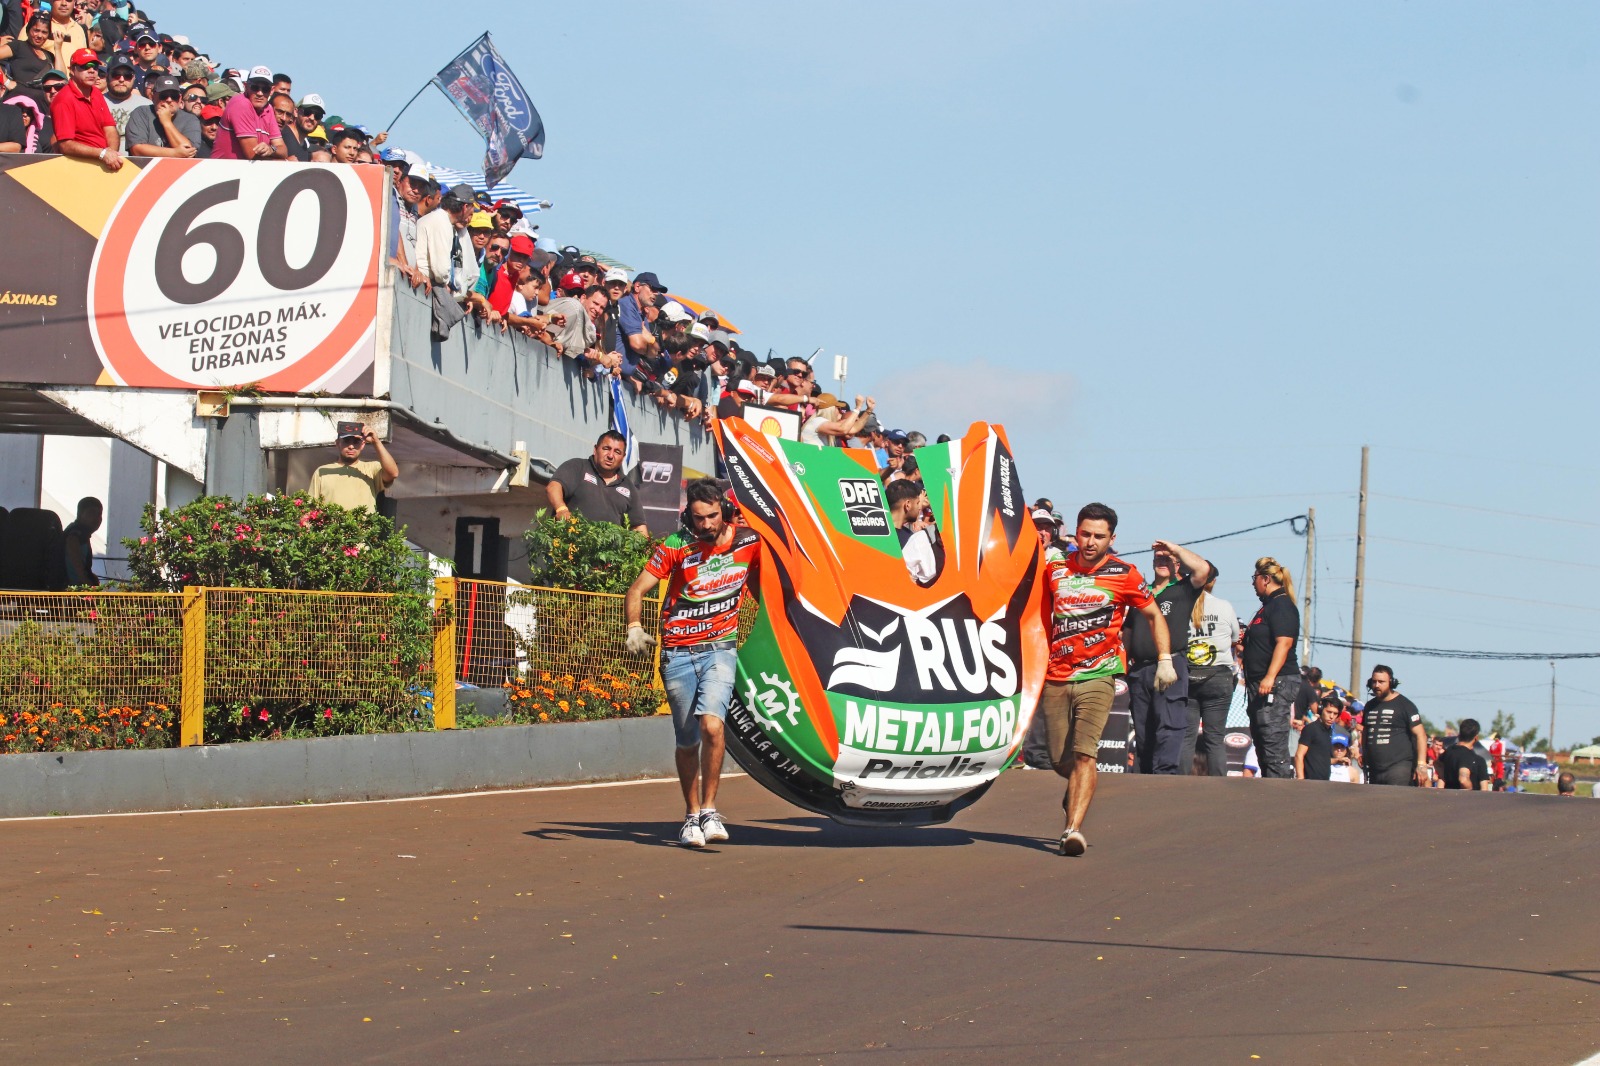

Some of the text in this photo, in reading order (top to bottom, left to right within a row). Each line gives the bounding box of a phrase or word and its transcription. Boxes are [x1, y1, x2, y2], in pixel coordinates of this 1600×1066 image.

[154, 168, 348, 305] 60
[0, 290, 58, 306] ÁXIMAS
[158, 302, 327, 340] VELOCIDAD MÁX.
[189, 326, 288, 354] EN ZONAS
[191, 345, 287, 372] URBANAS
[839, 482, 879, 503] DRF
[852, 516, 885, 527] SEGUROS
[468, 524, 484, 574] 1
[697, 556, 735, 575] METALFOR
[672, 621, 713, 635] Prialis
[902, 616, 1018, 698] RUS
[728, 698, 755, 733] SILVA
[843, 699, 1016, 753] METALFOR
[858, 756, 987, 780] Prialis
[862, 799, 940, 808] COMBUSTIBLES
